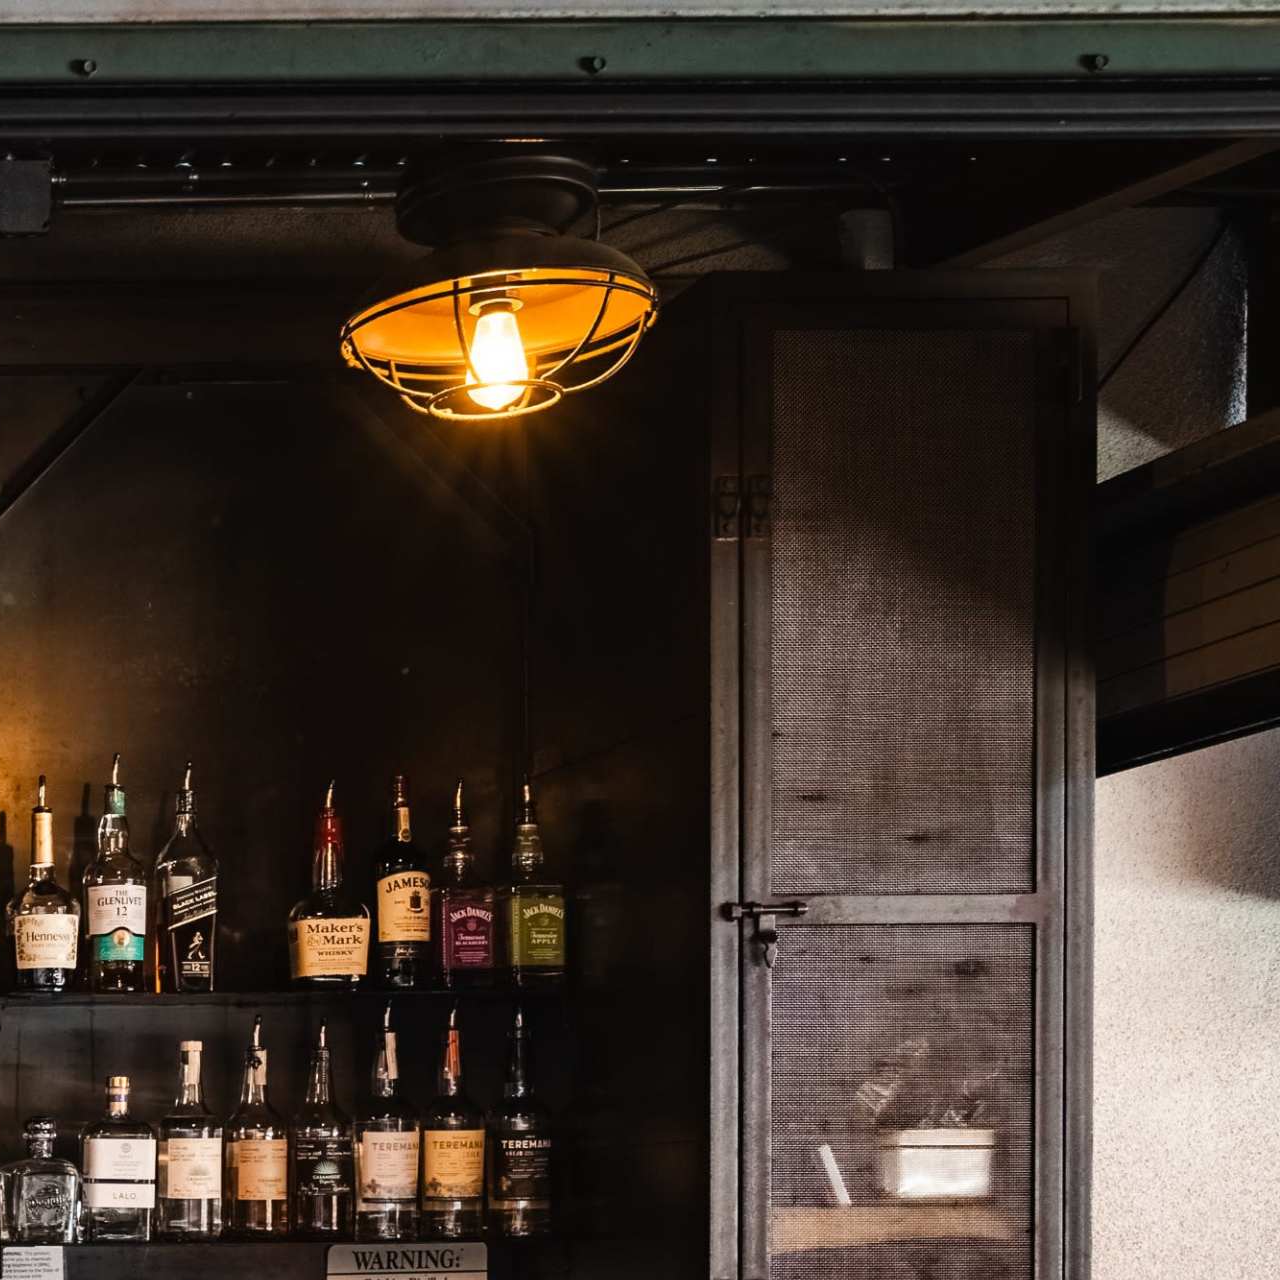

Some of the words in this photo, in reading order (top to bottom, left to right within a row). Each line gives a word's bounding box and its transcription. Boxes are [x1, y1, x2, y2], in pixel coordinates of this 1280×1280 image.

[97, 897, 142, 906] GLENLIVET
[116, 907, 128, 916] 12
[307, 924, 363, 934] Maker's
[322, 934, 362, 945] Mark
[191, 963, 201, 971] 12
[113, 1192, 137, 1200] LALO
[353, 1249, 461, 1271] WARNING:
